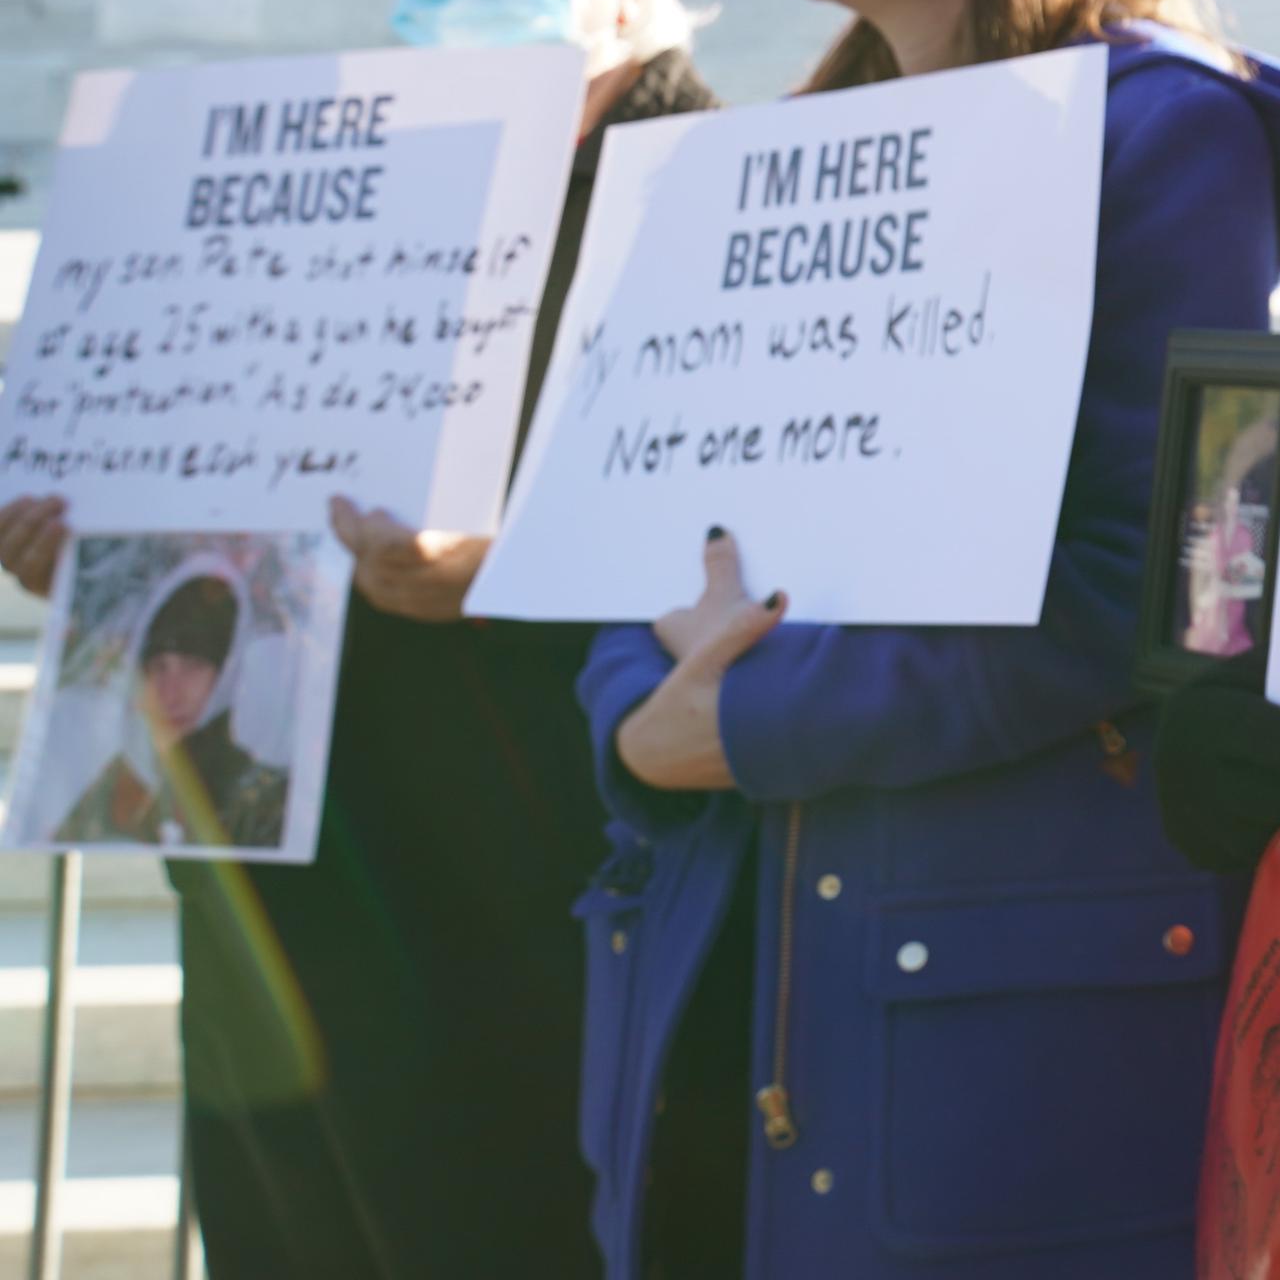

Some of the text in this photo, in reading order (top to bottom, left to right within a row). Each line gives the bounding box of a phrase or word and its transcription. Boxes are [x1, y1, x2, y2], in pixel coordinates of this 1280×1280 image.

[202, 94, 396, 158] I'M HERE
[184, 166, 387, 229] BECAUSE
[736, 128, 934, 212] I'M HERE
[384, 233, 532, 277] himself
[720, 211, 930, 292] BECAUSE
[635, 320, 744, 377] mom
[767, 313, 858, 360] was
[602, 415, 686, 481] Not
[698, 422, 764, 468] one
